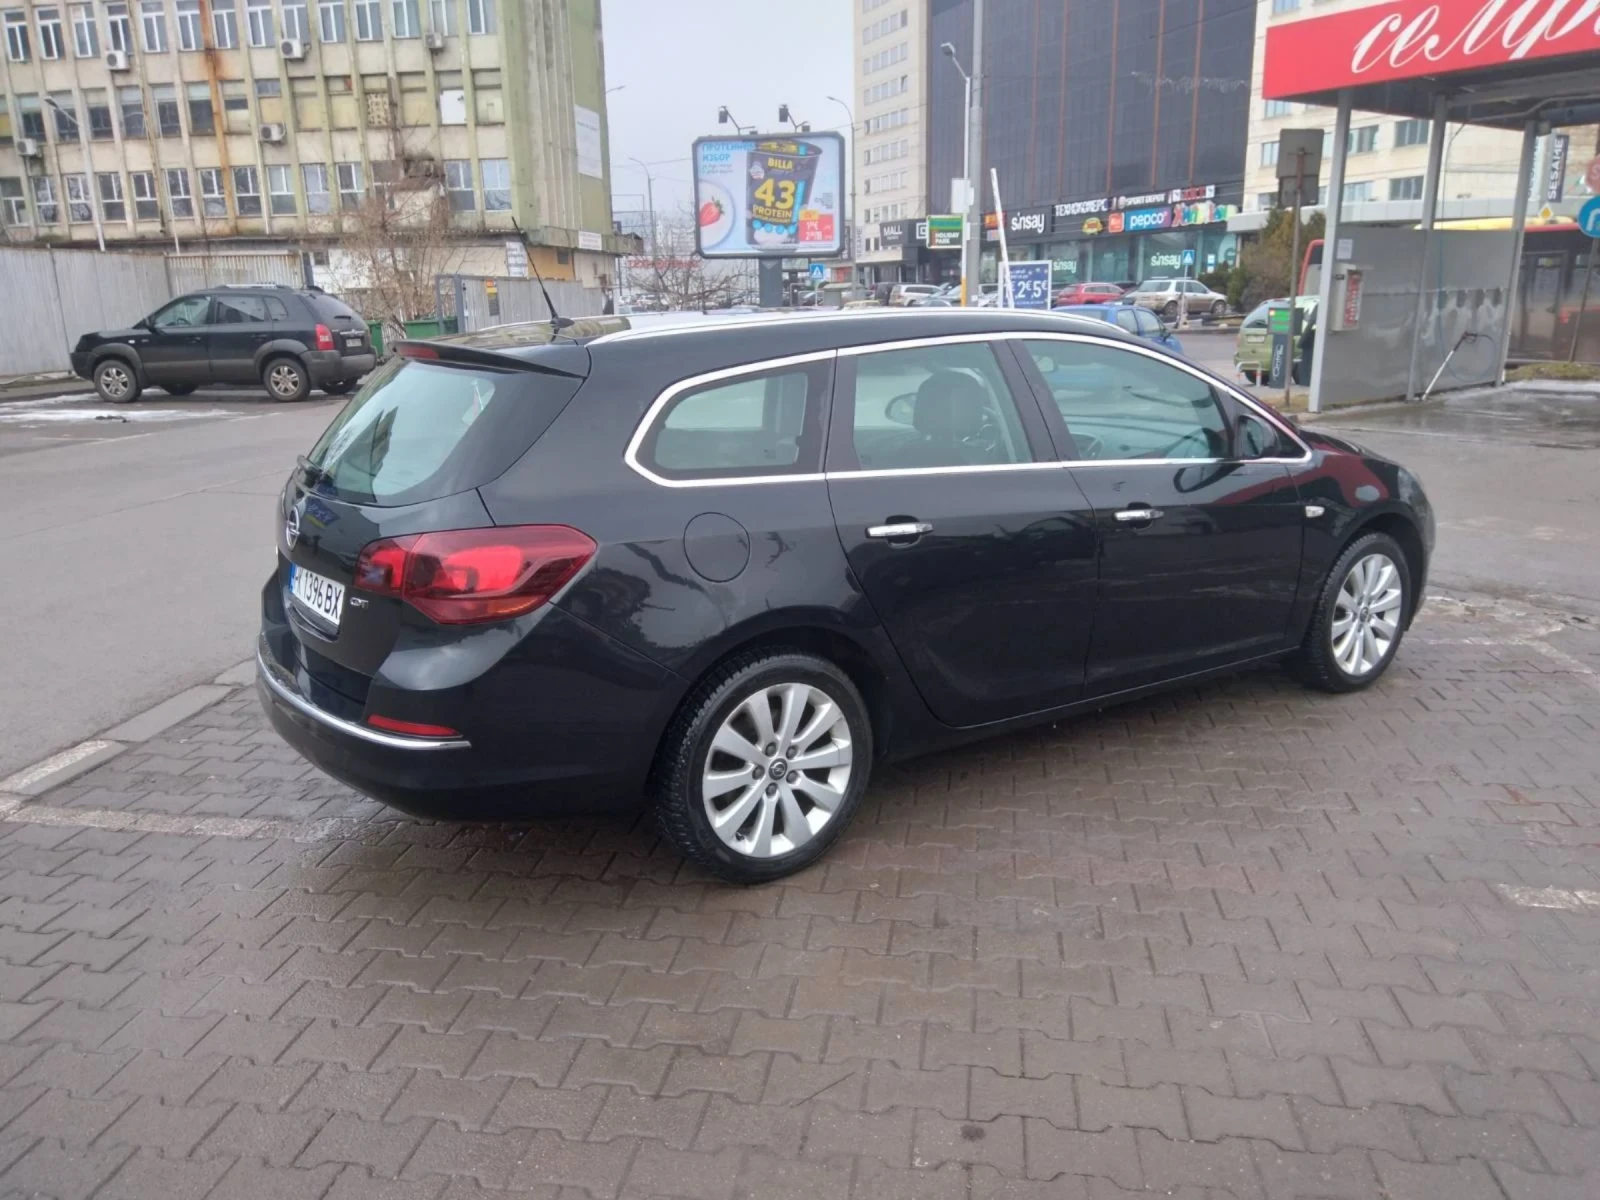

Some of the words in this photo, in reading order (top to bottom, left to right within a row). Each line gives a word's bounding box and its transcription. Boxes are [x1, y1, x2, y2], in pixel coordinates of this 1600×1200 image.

[768, 158, 793, 169] BILLA
[1547, 137, 1565, 200] SESAME
[754, 178, 796, 210] 43
[752, 204, 792, 219] PROTEIN
[1130, 211, 1164, 229] pepco
[883, 225, 903, 236] MALL
[1011, 211, 1045, 234] sinsay
[1053, 258, 1077, 273] sinsay
[1151, 252, 1181, 269] sinsay
[304, 571, 325, 609] 1396
[324, 583, 343, 619] BX
